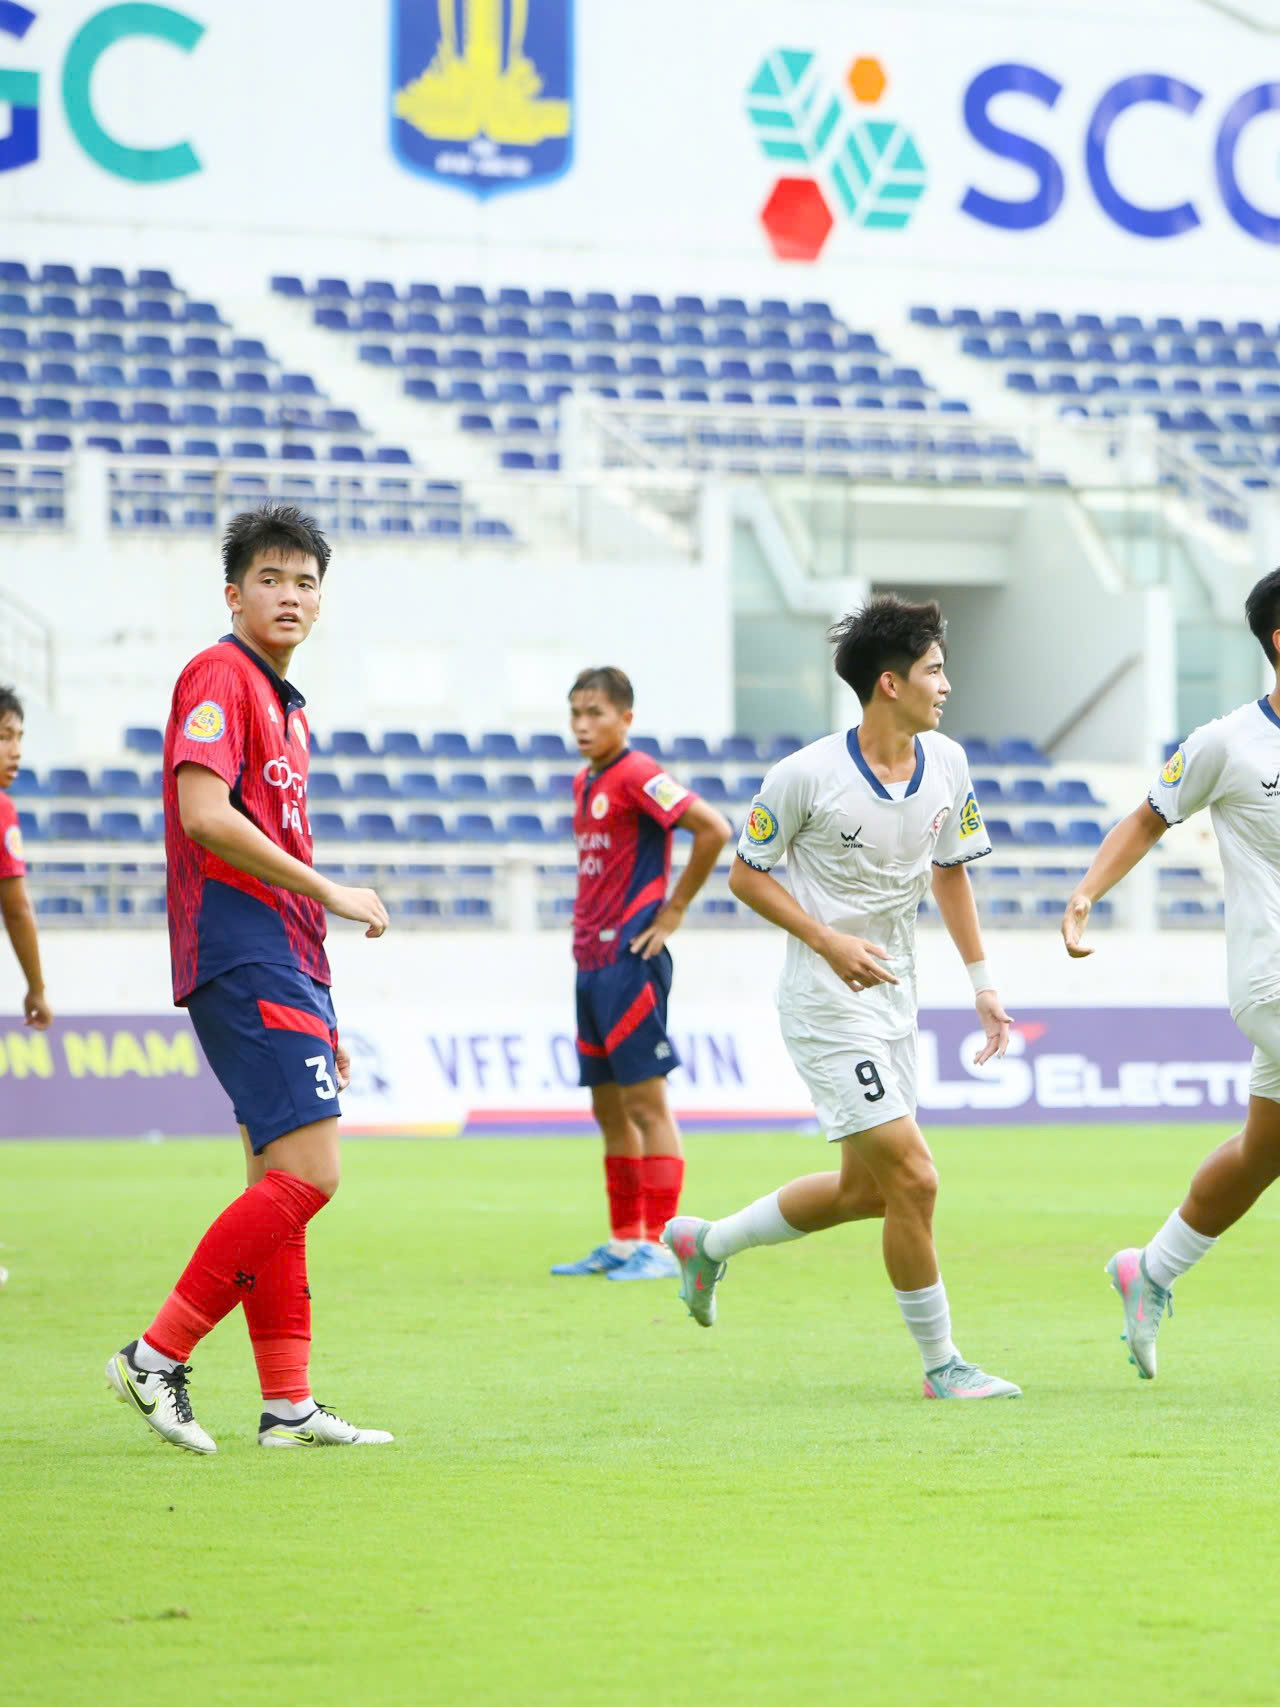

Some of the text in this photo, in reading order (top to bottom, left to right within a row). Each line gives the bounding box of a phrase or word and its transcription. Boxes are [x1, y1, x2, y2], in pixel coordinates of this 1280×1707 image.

[62, 1030, 200, 1079] NAM
[304, 1055, 336, 1100] 3
[855, 1060, 886, 1103] 9
